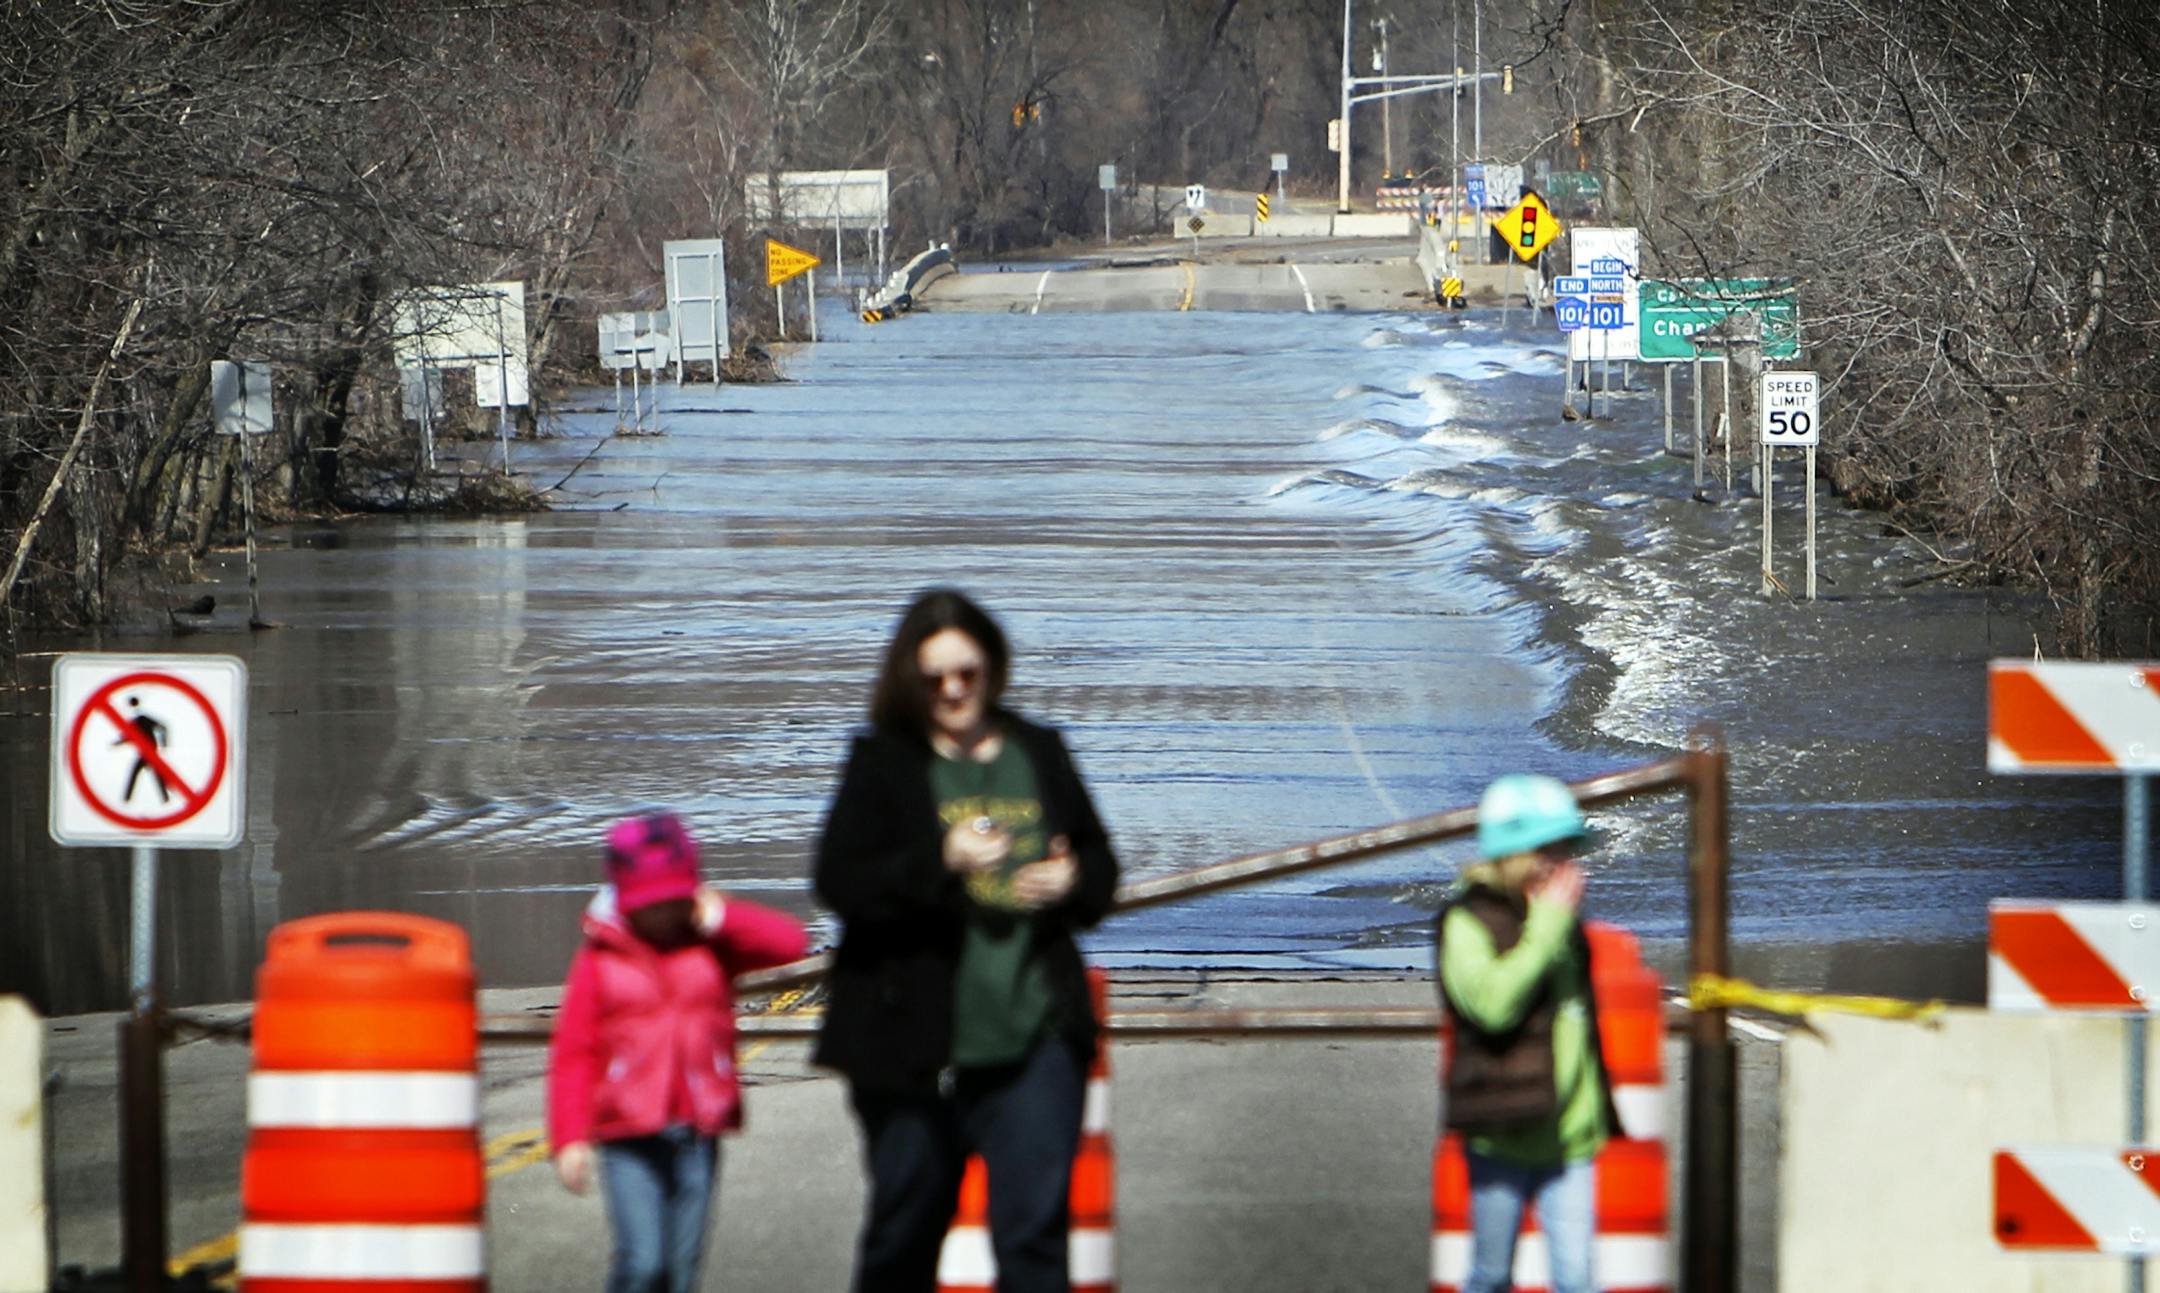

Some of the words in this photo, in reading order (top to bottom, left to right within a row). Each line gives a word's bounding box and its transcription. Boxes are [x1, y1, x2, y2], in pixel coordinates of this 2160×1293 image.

[1467, 180, 1484, 191] 101
[770, 257, 807, 265] PASSING
[1592, 261, 1622, 273] BEGIN
[1560, 280, 1584, 292] END
[1591, 279, 1622, 292] NORTH
[1559, 307, 1583, 322] 101
[1593, 307, 1619, 325] 101
[1767, 381, 1813, 392] SPEED
[1771, 396, 1807, 407] LIMIT
[1768, 411, 1811, 436] 50
